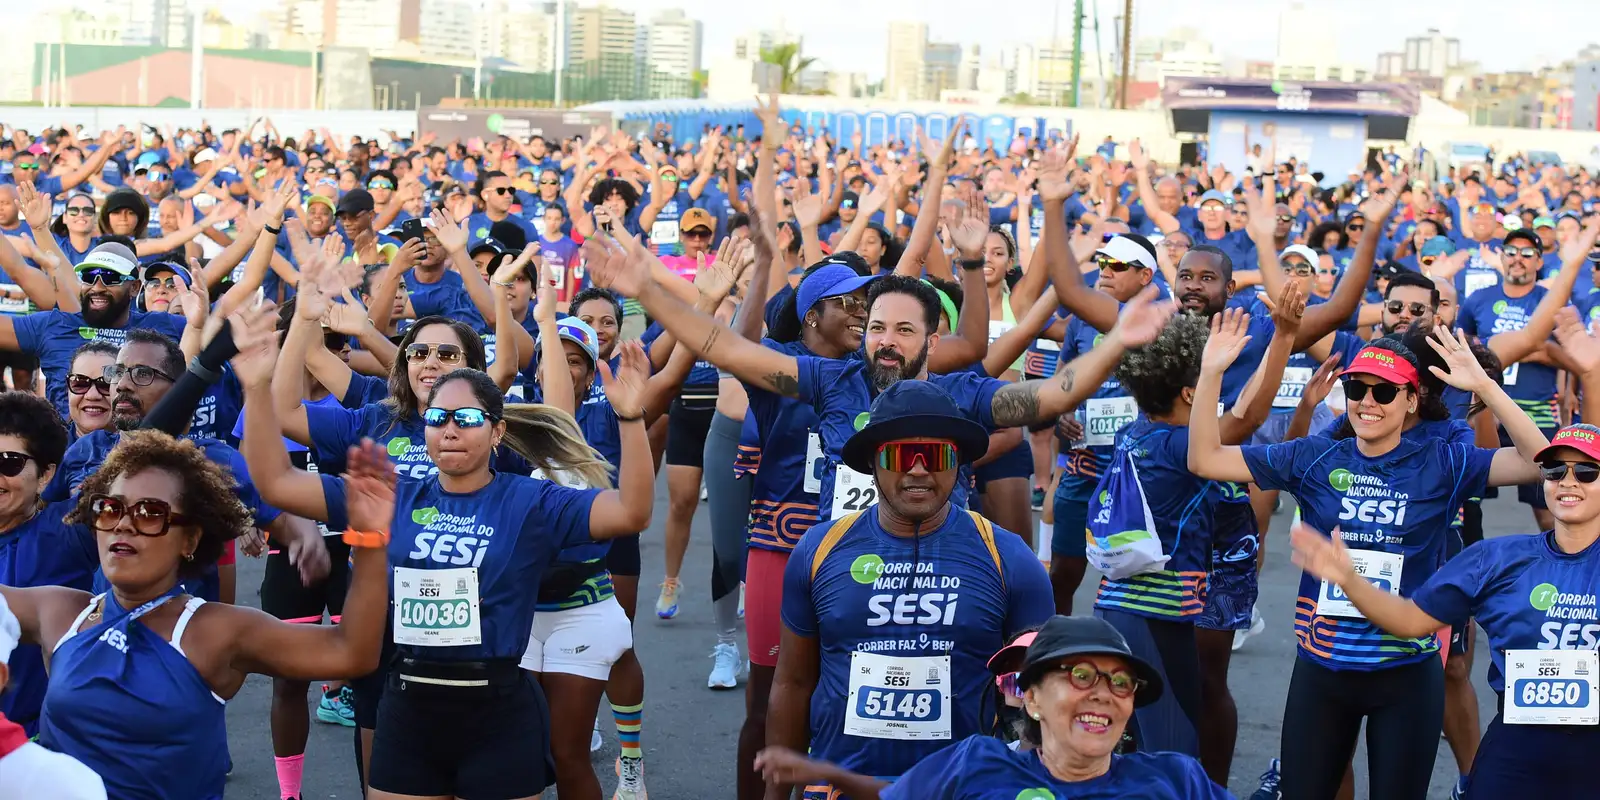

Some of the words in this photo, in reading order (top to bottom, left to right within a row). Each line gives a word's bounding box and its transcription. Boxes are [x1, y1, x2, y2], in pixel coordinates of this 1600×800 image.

[1492, 318, 1528, 333] SES
[94, 328, 127, 338] CORRIDA
[1376, 352, 1394, 364] days
[1276, 383, 1305, 397] 077
[1574, 430, 1595, 441] days
[404, 444, 428, 453] CORR
[398, 452, 434, 463] NACION
[431, 513, 476, 526] CORRIDA
[423, 523, 475, 535] NACIONAL
[477, 524, 494, 537] DO
[1330, 530, 1358, 542] CRRER
[1360, 533, 1374, 543] FAZ
[941, 576, 960, 589] DO
[1551, 592, 1596, 606] CORRIDA
[401, 600, 470, 627] 10036
[1546, 605, 1598, 620] NACIONAL
[857, 639, 897, 652] CORRER
[898, 639, 917, 651] FAZ
[932, 639, 955, 651] BEM
[861, 666, 871, 675] 5K
[1522, 681, 1581, 705] 6850
[864, 690, 932, 719] 5148
